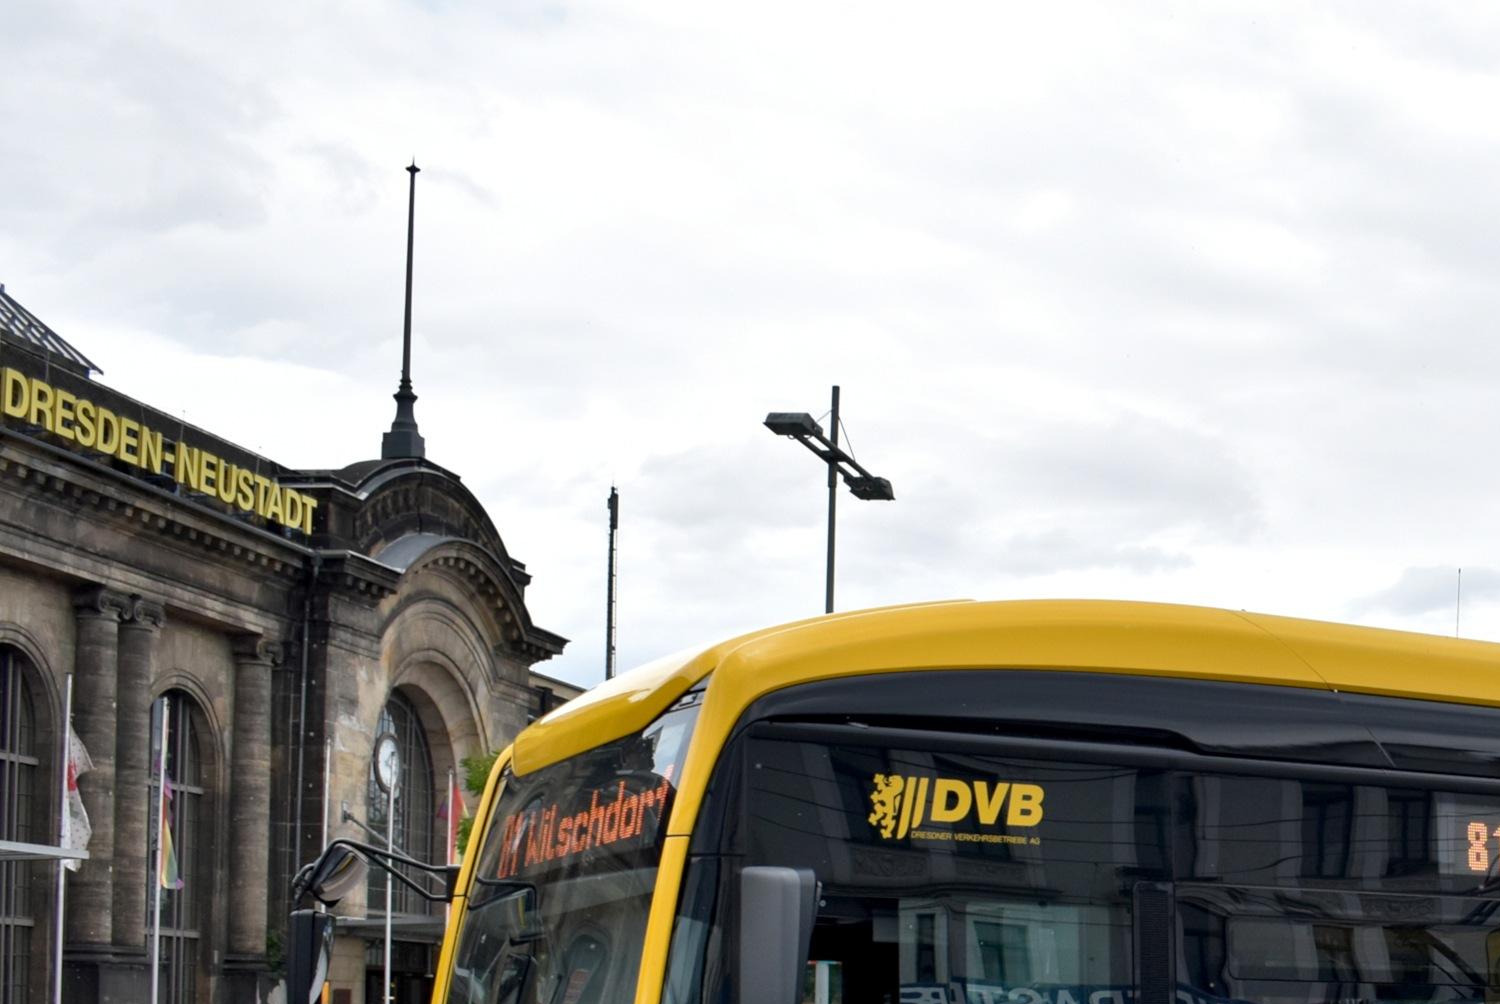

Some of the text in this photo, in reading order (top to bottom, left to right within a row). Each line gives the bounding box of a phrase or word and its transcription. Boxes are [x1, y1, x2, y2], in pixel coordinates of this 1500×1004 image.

[2, 366, 317, 535] DRESDEN-NEUSTADT
[931, 778, 1045, 827] DVB
[911, 831, 1041, 845] DRESDNER VERKEHRSBETRIEBE AG
